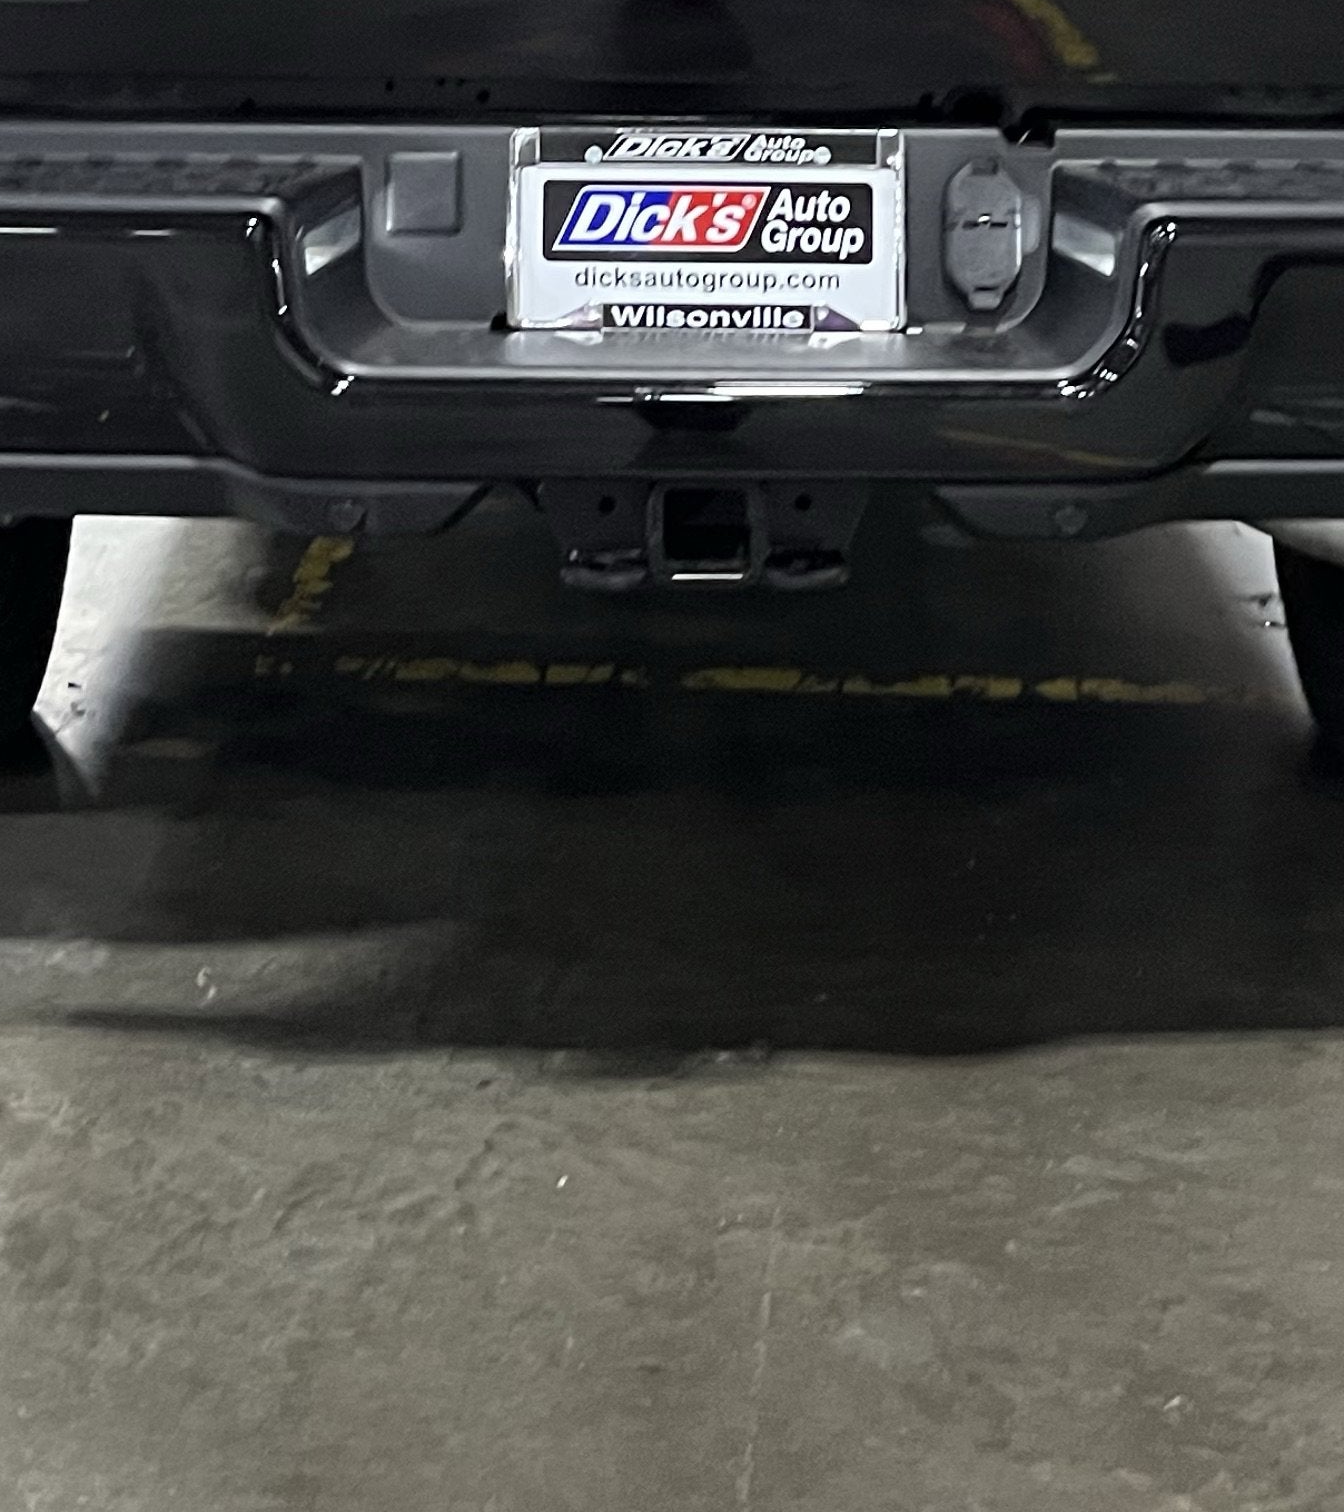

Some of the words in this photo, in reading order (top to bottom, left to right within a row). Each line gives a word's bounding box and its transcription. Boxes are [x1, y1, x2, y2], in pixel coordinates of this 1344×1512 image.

[755, 134, 806, 150] Auto
[743, 146, 815, 165] Group
[568, 190, 749, 243] Dick's
[767, 189, 851, 223] Auto
[761, 221, 865, 260] Group
[574, 266, 840, 292] dicksautogroup.com
[610, 305, 805, 328] Wilsonville
